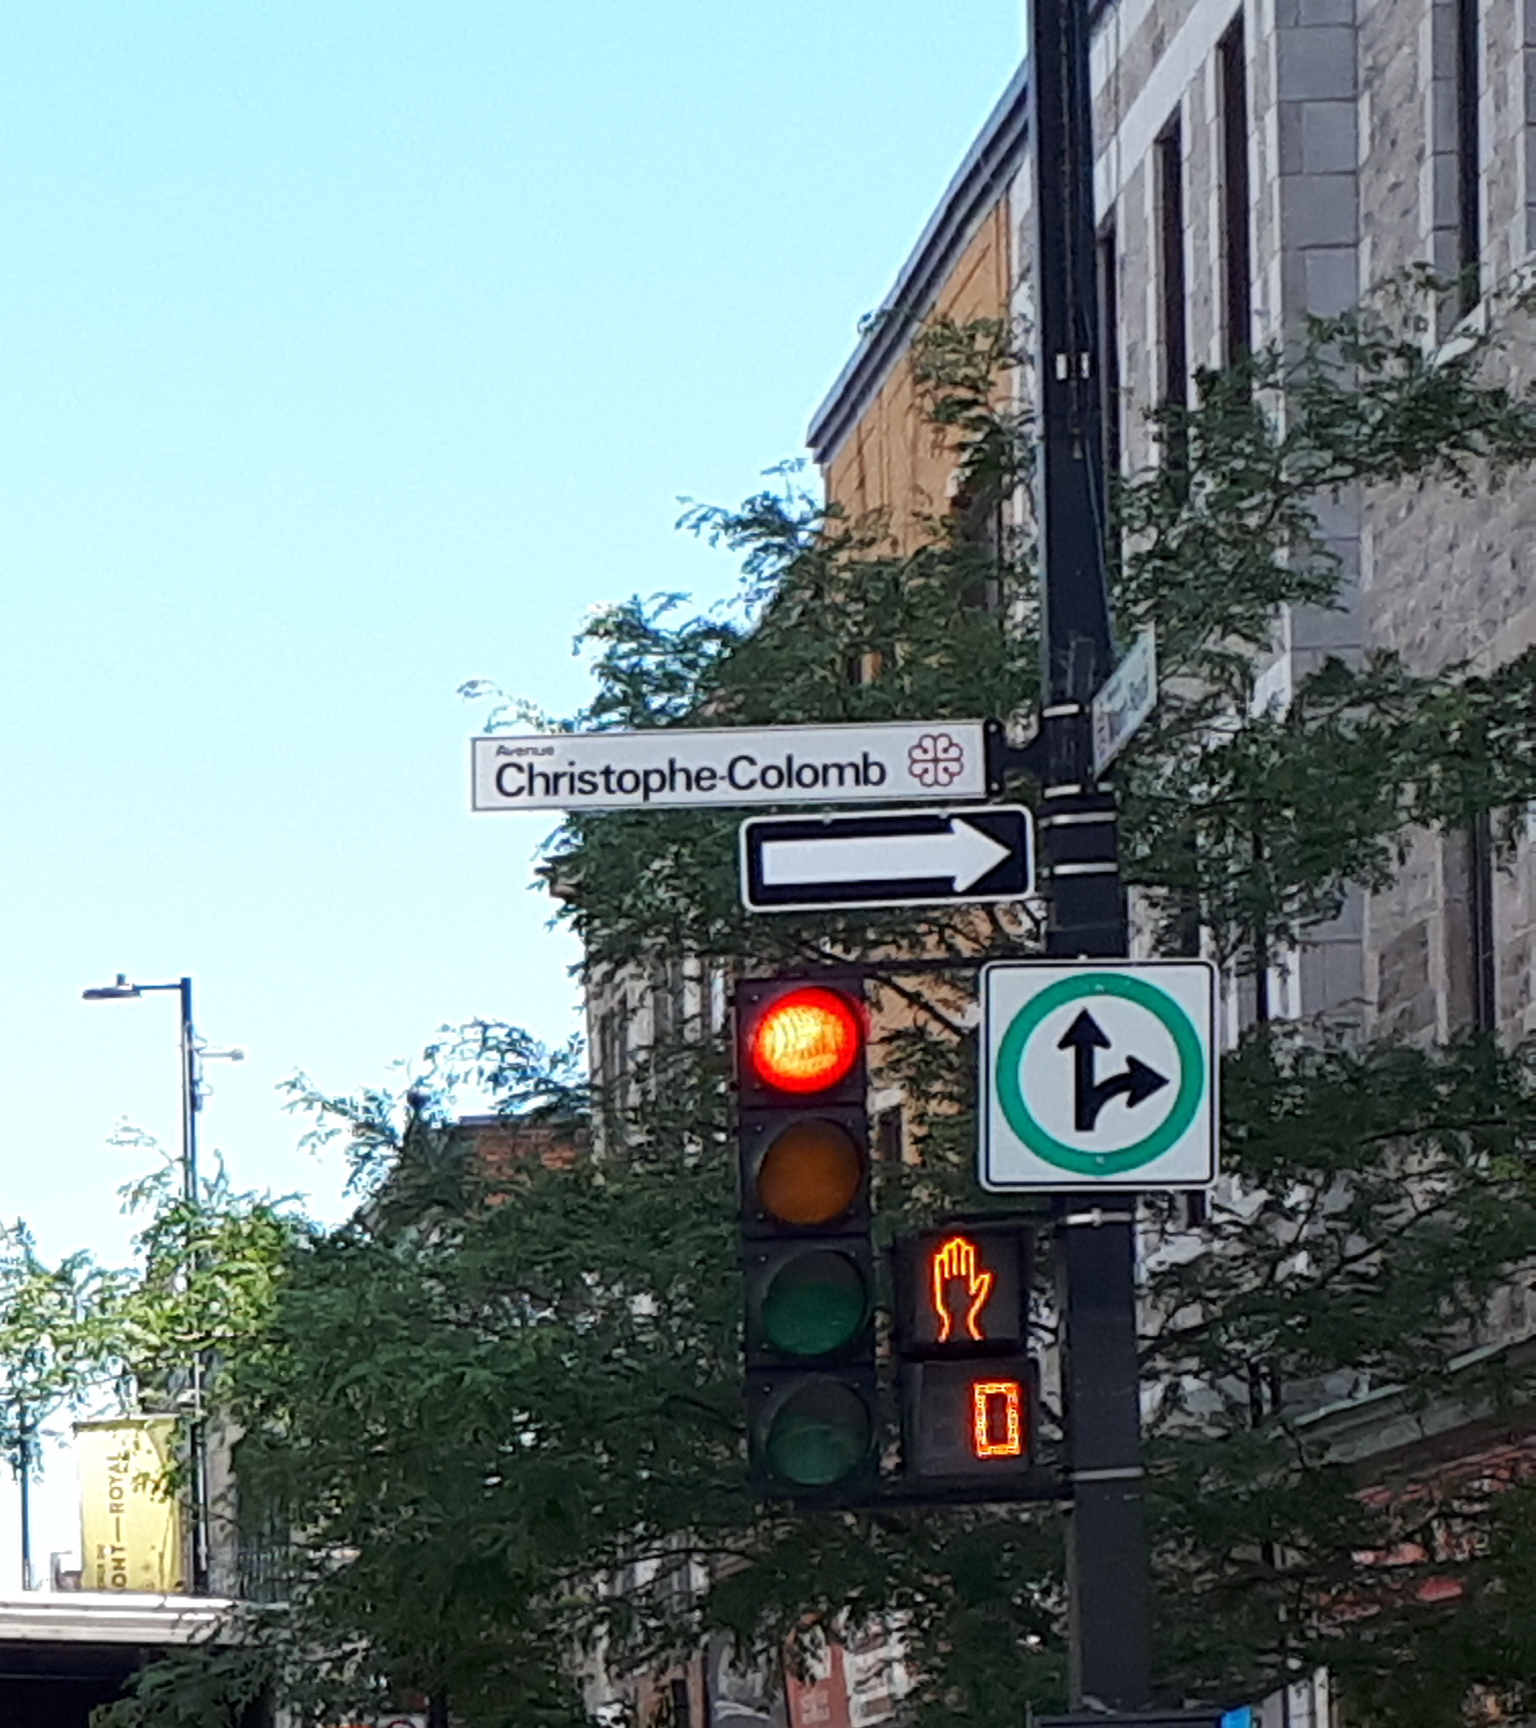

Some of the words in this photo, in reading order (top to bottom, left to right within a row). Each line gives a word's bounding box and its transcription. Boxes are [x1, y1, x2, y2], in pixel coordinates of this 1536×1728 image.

[495, 744, 555, 757] Avenue
[494, 751, 887, 801] Christophe-Colomb
[974, 1382, 1021, 1458] 0
